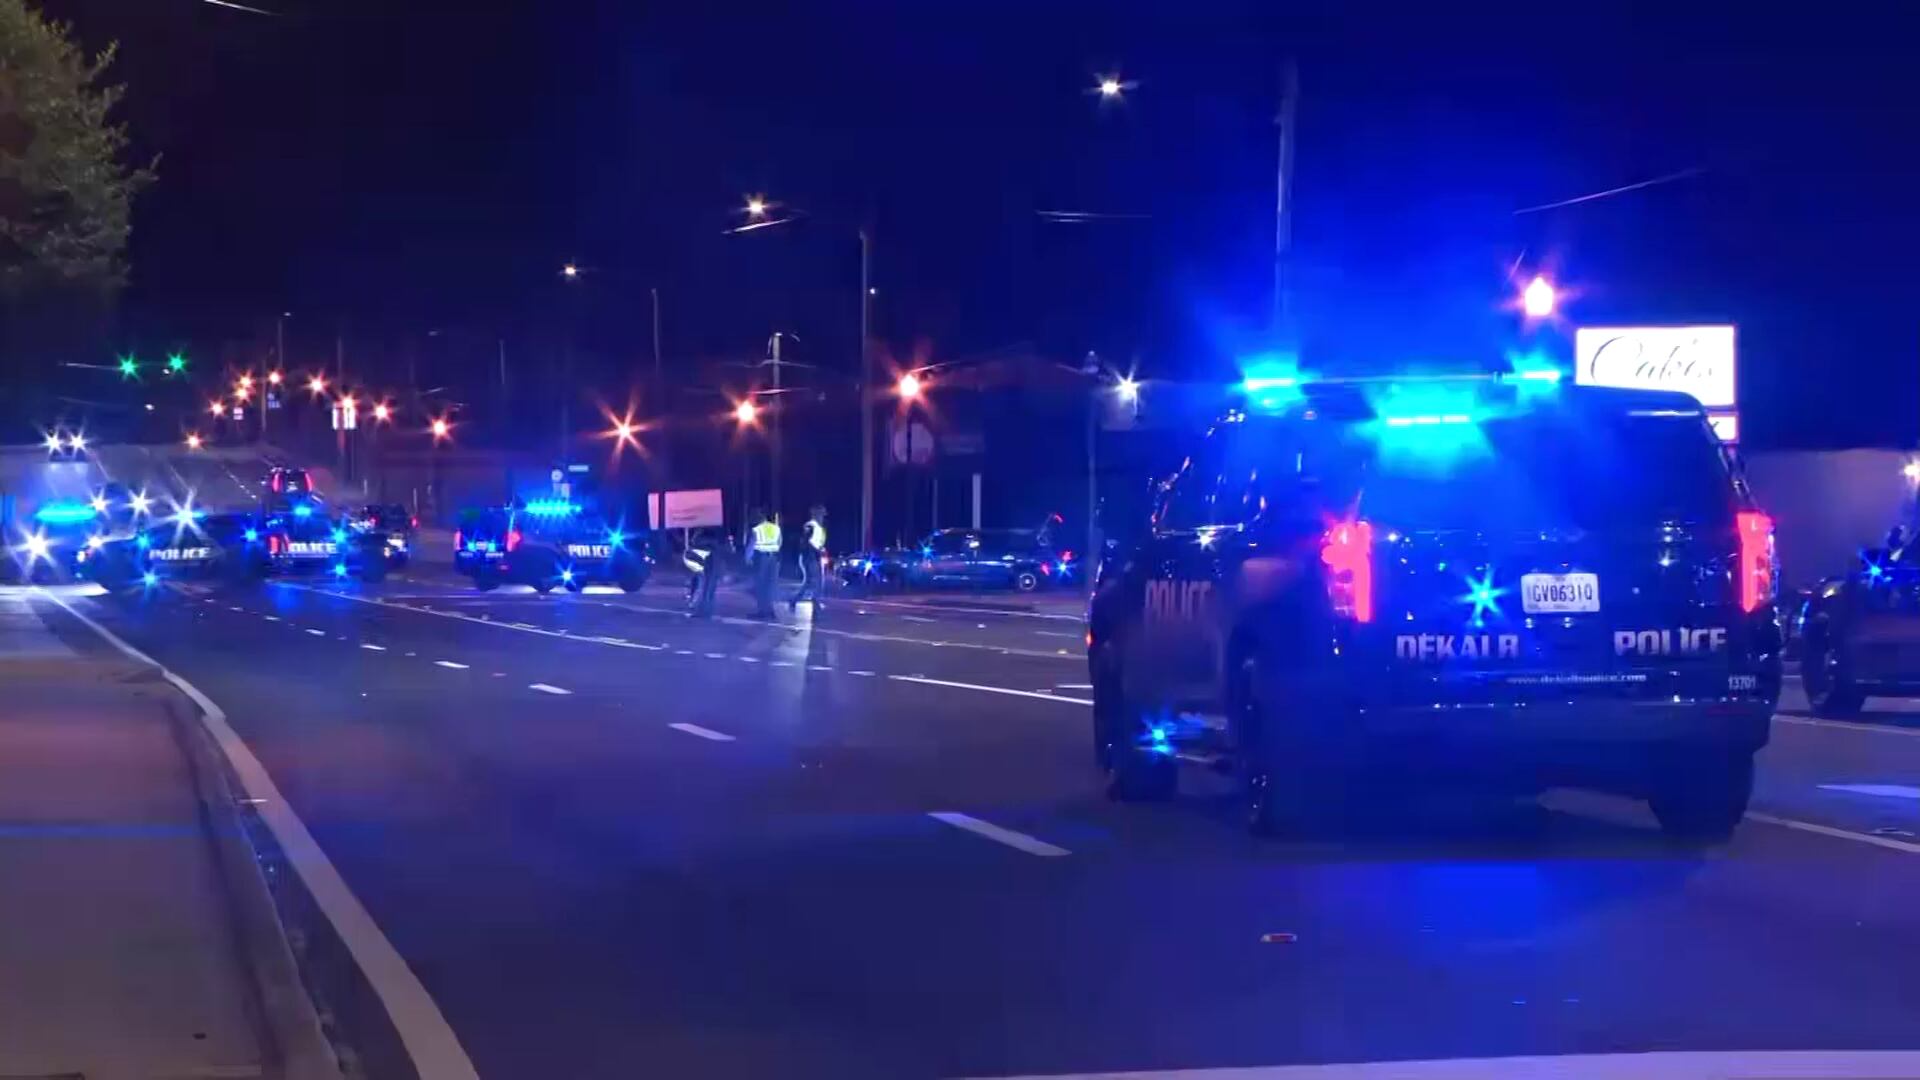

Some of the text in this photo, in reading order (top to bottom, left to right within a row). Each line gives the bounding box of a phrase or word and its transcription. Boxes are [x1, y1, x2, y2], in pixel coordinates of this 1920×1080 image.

[149, 547, 210, 560] POLICE
[567, 544, 612, 558] POLICE
[1613, 627, 1726, 656] POLICE
